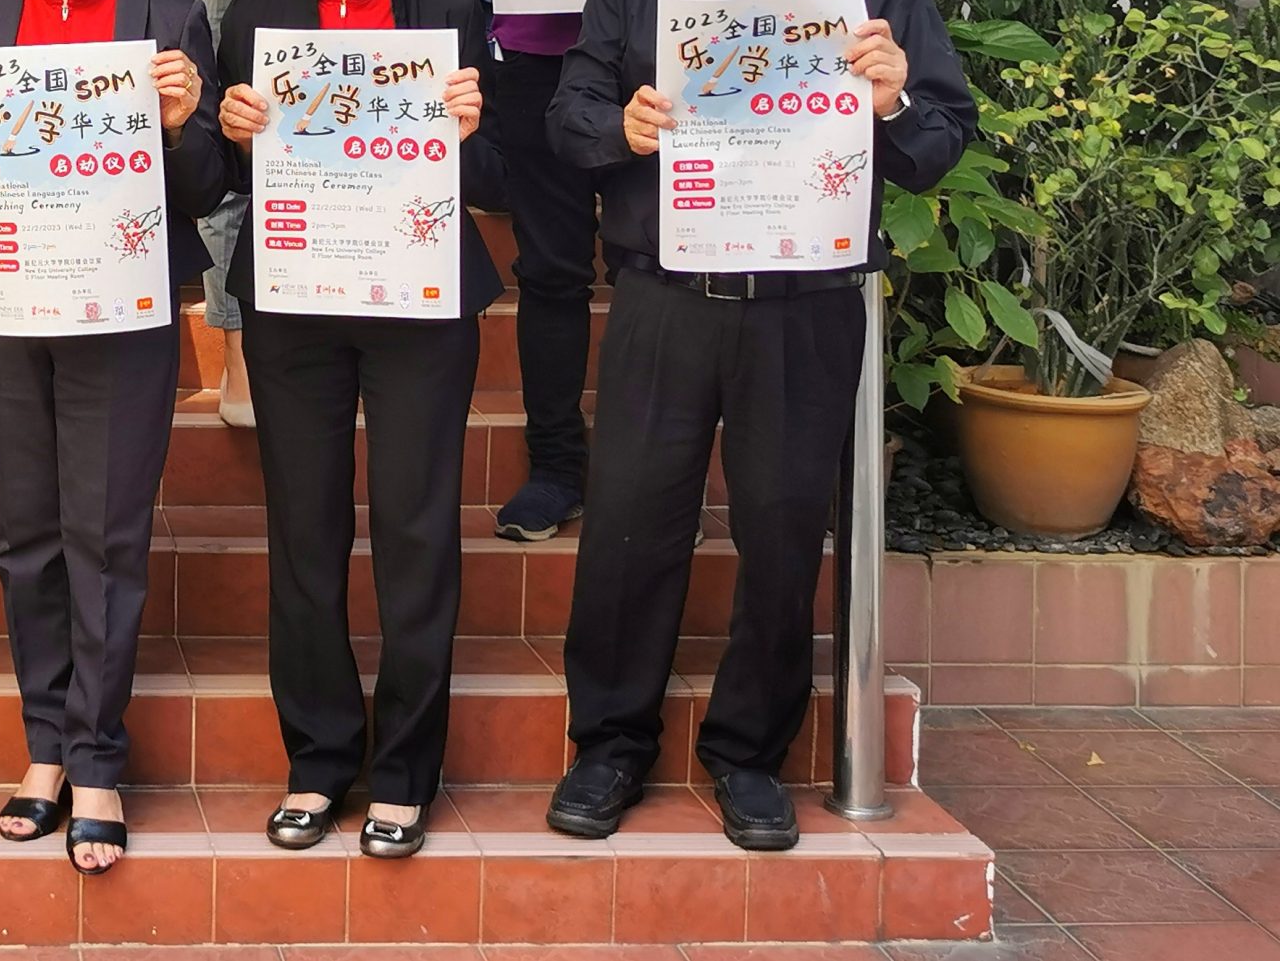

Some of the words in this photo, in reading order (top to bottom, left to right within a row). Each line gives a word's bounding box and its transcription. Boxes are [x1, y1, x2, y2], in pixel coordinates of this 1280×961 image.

[670, 9, 728, 31] 2023
[724, 15, 776, 40] 全国
[784, 16, 848, 43] SPM
[264, 42, 317, 66] 2023
[312, 52, 365, 76] 全国
[373, 58, 434, 85] SPM
[16, 68, 68, 92] 全国
[76, 70, 135, 100] SPM
[368, 96, 448, 122] 华文班
[754, 95, 856, 112] 启动仪式
[71, 112, 151, 139] 华文班
[346, 138, 444, 160] 启动仪式
[53, 154, 150, 175] 启动仪式
[266, 179, 315, 193] Launching
[323, 180, 373, 195] Ceremony
[32, 200, 81, 213] Ceremony
